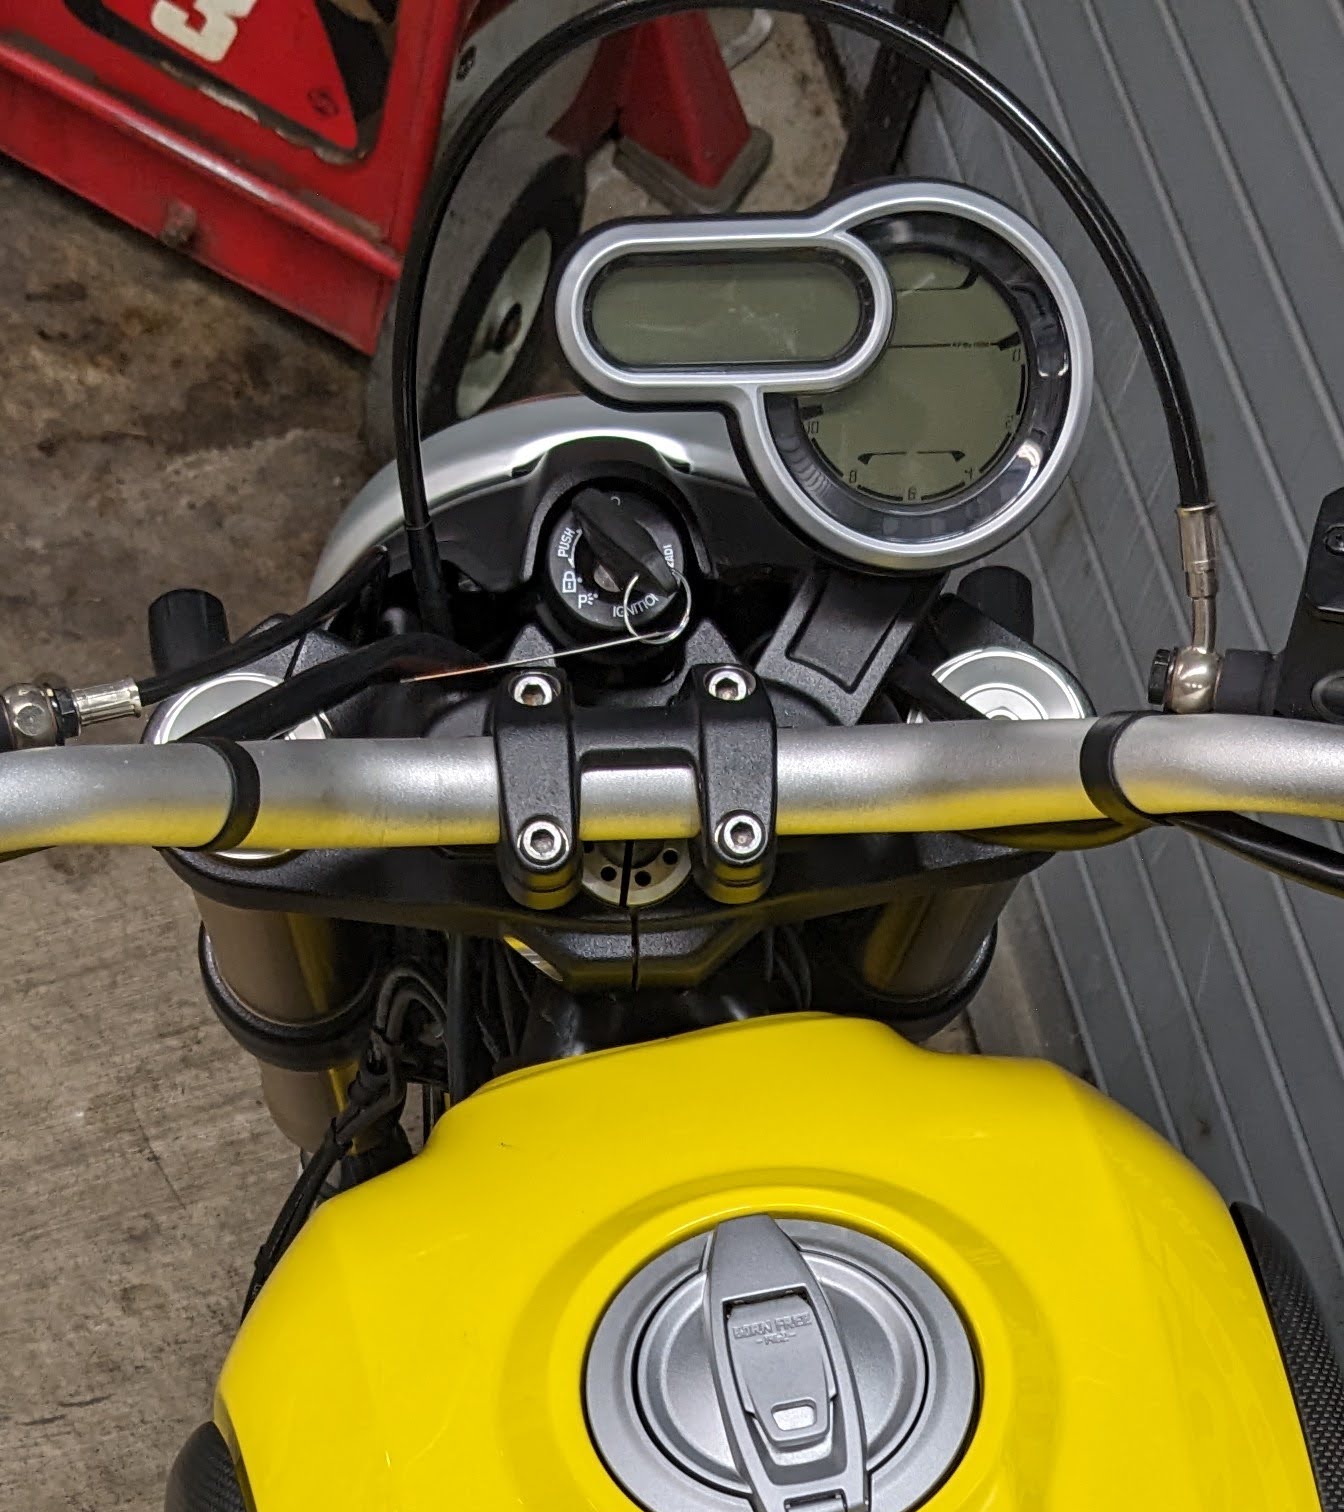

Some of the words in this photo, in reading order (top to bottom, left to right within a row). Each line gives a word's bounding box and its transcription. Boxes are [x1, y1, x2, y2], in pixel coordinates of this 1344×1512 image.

[557, 527, 575, 558] PUSH
[732, 1320, 773, 1340] BORN
[775, 1311, 813, 1332] FREE
